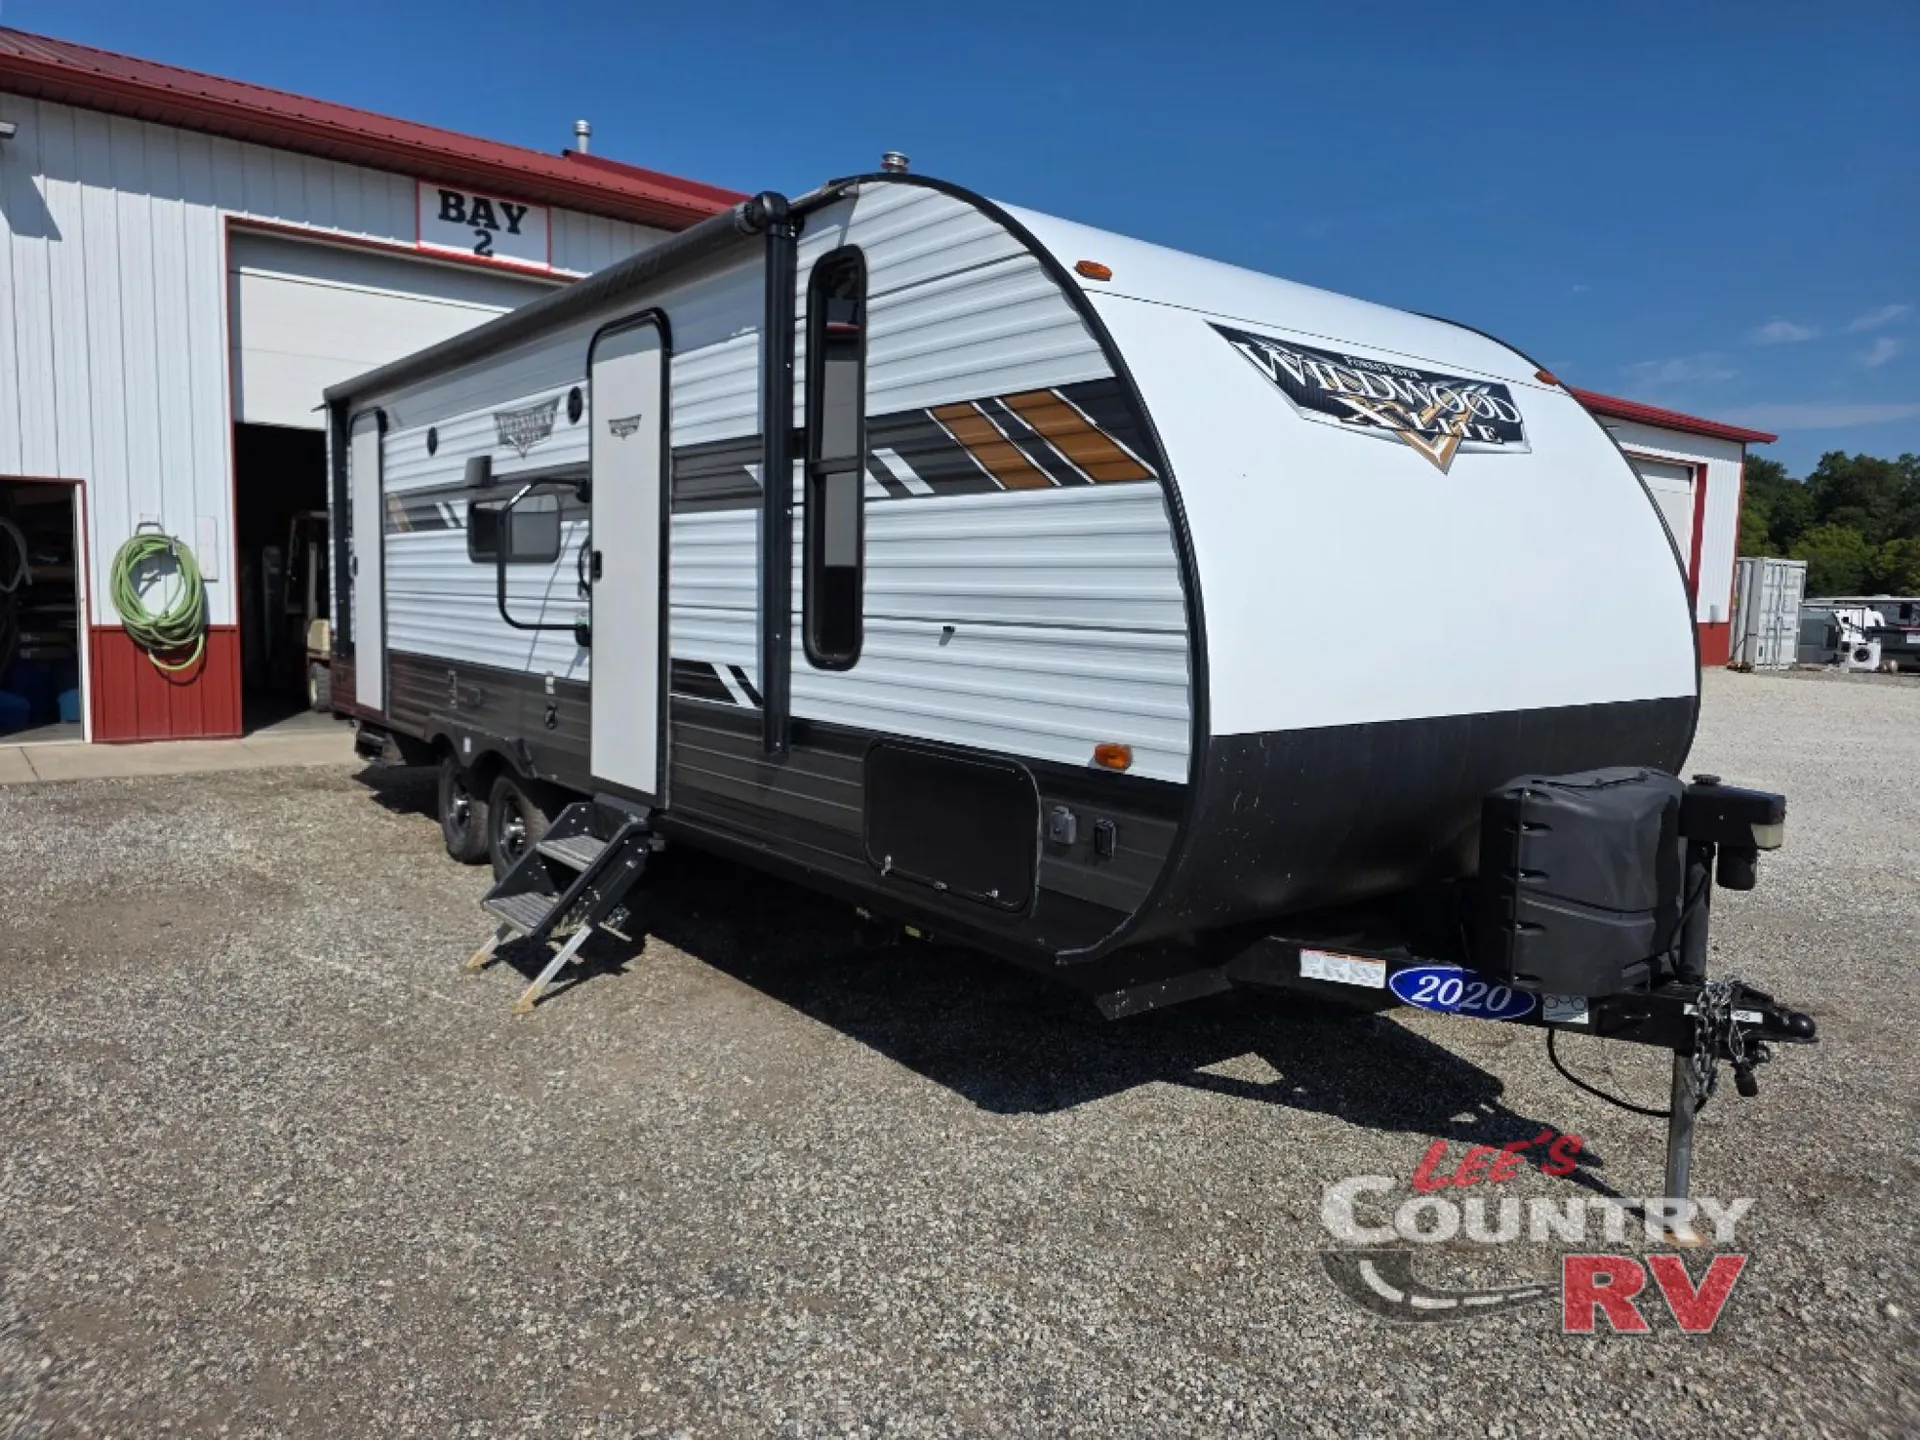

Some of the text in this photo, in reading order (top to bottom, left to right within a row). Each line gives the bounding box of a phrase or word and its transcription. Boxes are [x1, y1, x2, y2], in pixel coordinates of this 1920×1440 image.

[438, 189, 528, 235] BAY
[474, 229, 493, 257] 2
[1229, 340, 1522, 423] WILDWOOD
[1411, 974, 1513, 1012] 2020
